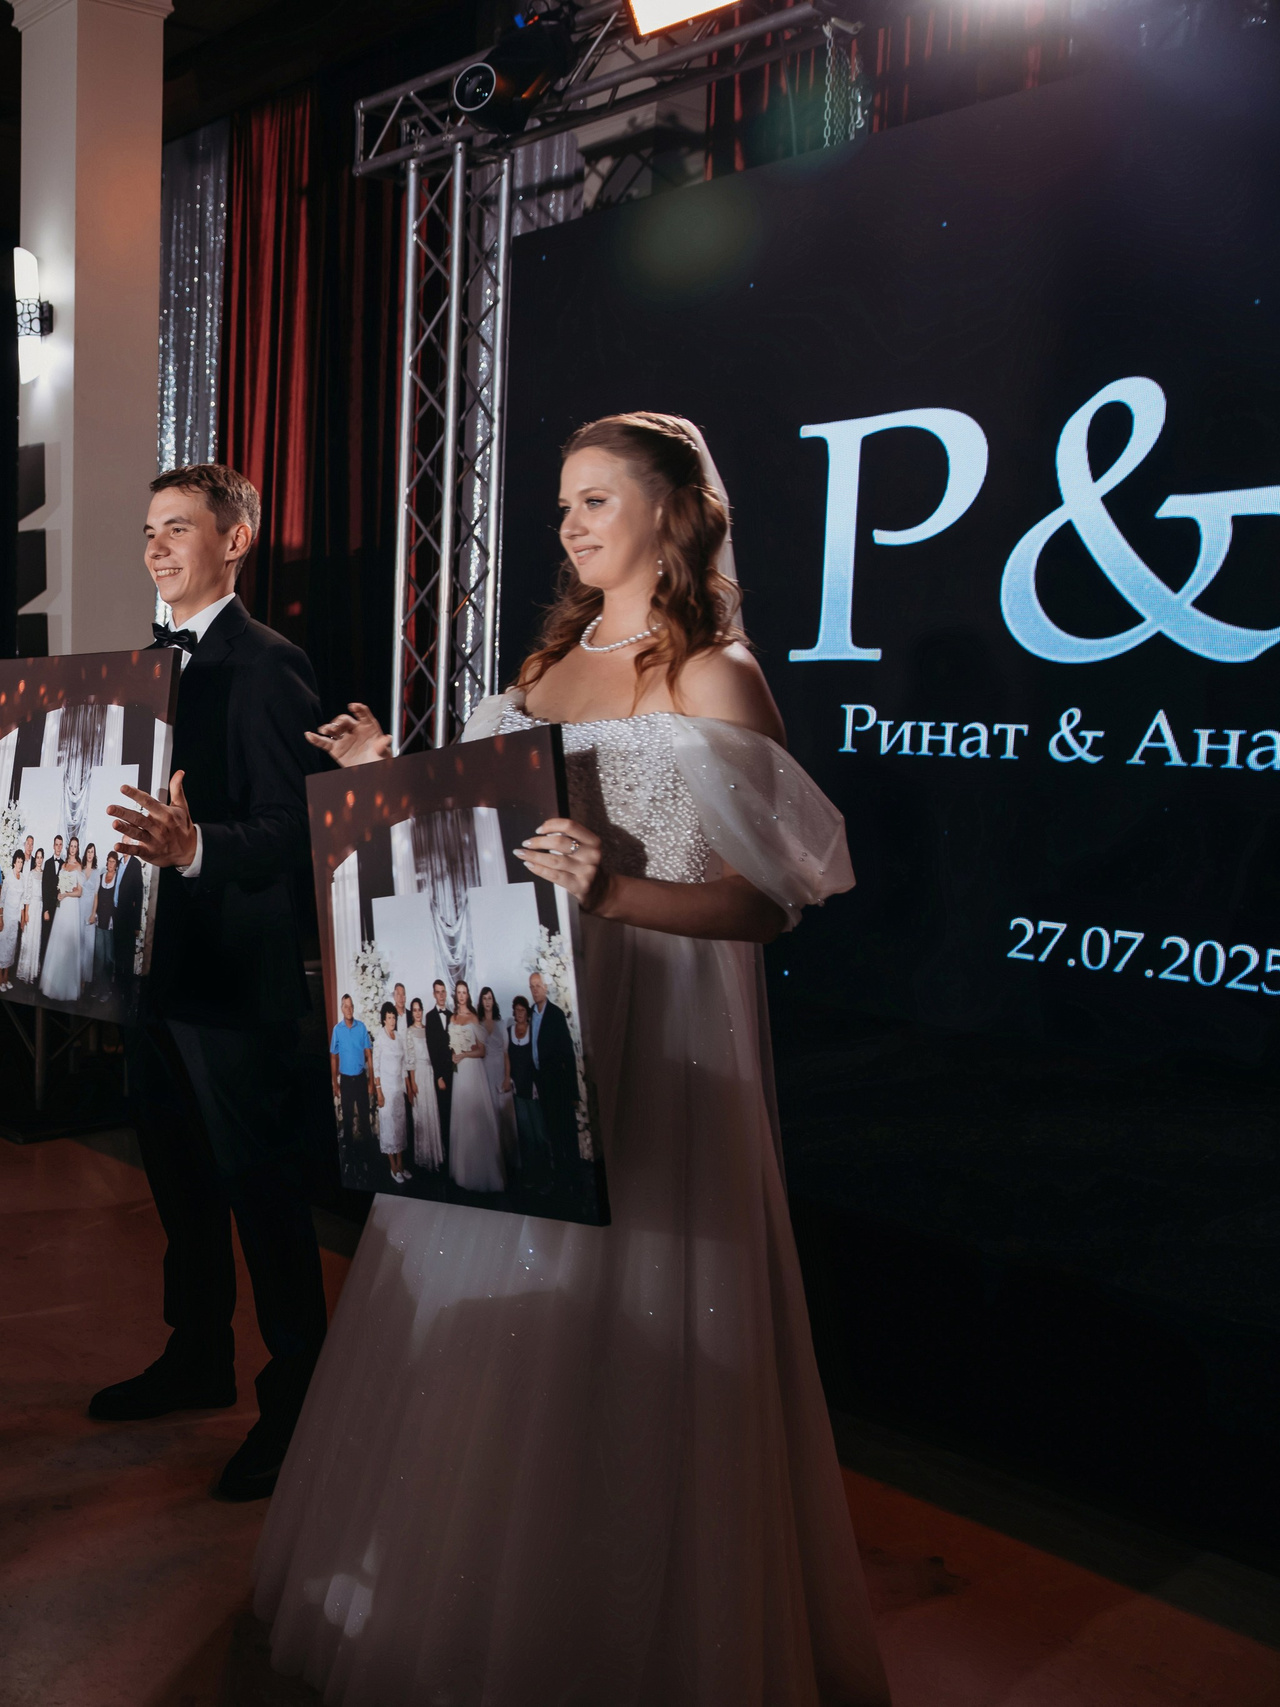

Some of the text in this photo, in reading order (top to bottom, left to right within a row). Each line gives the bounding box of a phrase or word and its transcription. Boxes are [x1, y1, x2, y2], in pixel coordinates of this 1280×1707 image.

[838, 703, 1280, 771] Ринат & Ана
[1006, 916, 1280, 996] 27.07.2025
